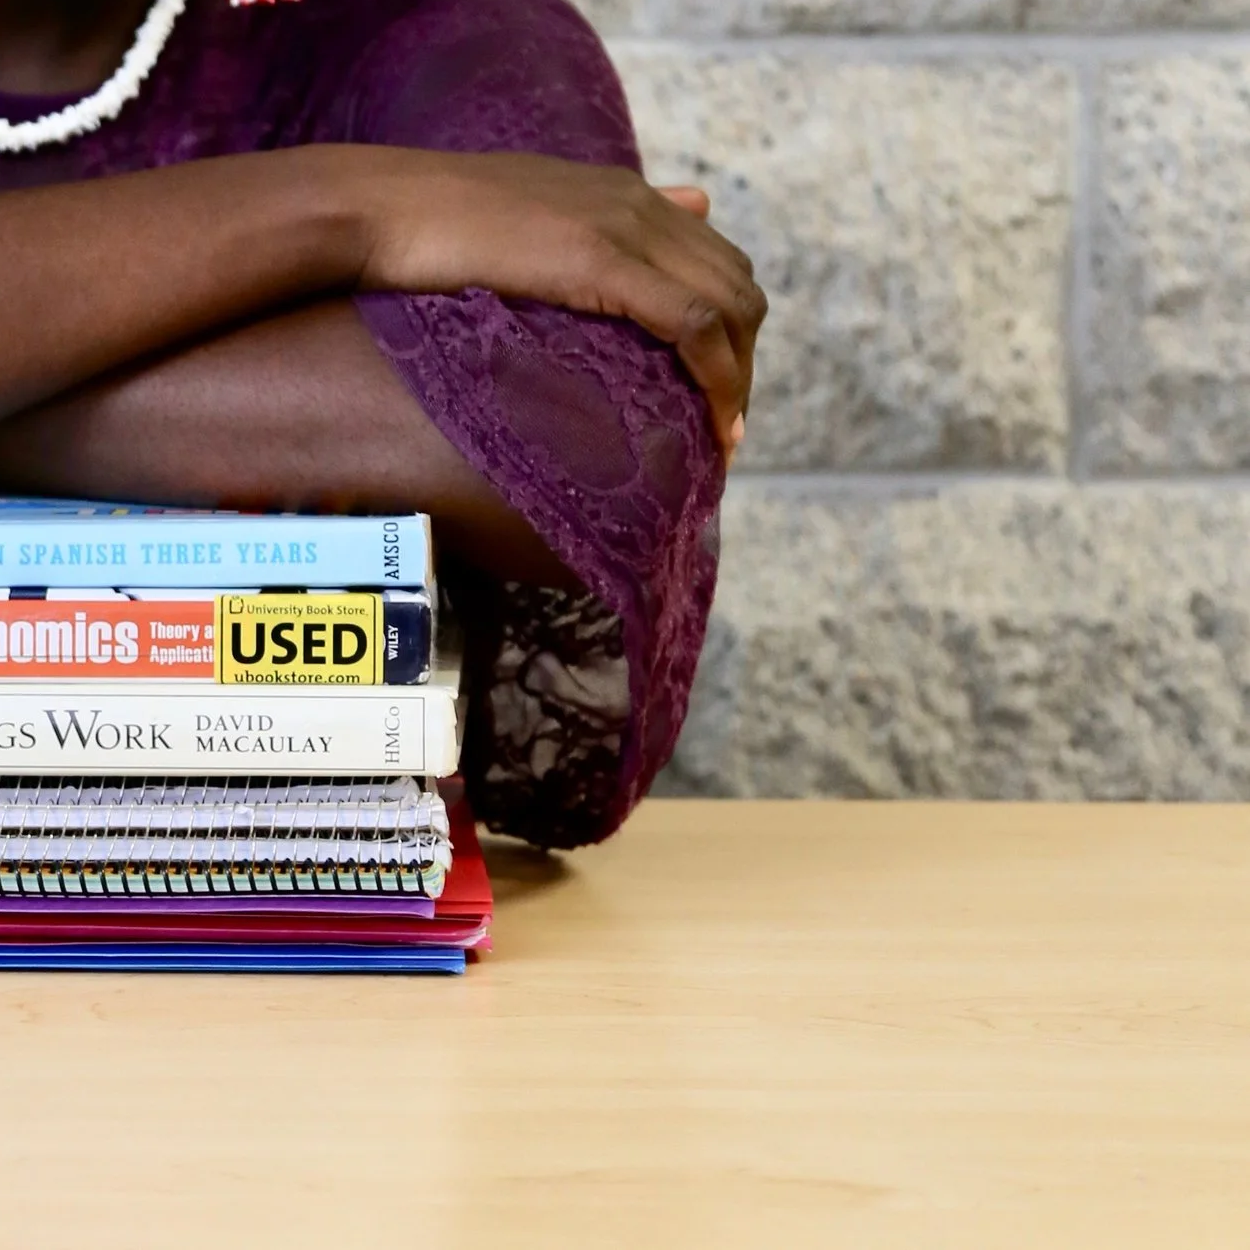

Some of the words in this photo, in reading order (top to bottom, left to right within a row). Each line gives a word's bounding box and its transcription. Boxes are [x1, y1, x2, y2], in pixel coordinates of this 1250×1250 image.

[19, 544, 126, 565] SPANISH
[141, 543, 222, 564] THREE
[237, 542, 317, 564] YEARS
[383, 522, 399, 580] AMSCO
[247, 604, 302, 617] University
[306, 604, 333, 615] Book
[149, 621, 200, 642] Theory
[388, 624, 399, 660] WILEY
[231, 622, 367, 665] USED
[234, 670, 360, 684] ubookstore.com
[43, 710, 173, 750] WORK
[195, 714, 274, 732] DAVID
[385, 706, 400, 763] HMCo
[195, 735, 333, 753] MACAULAY
